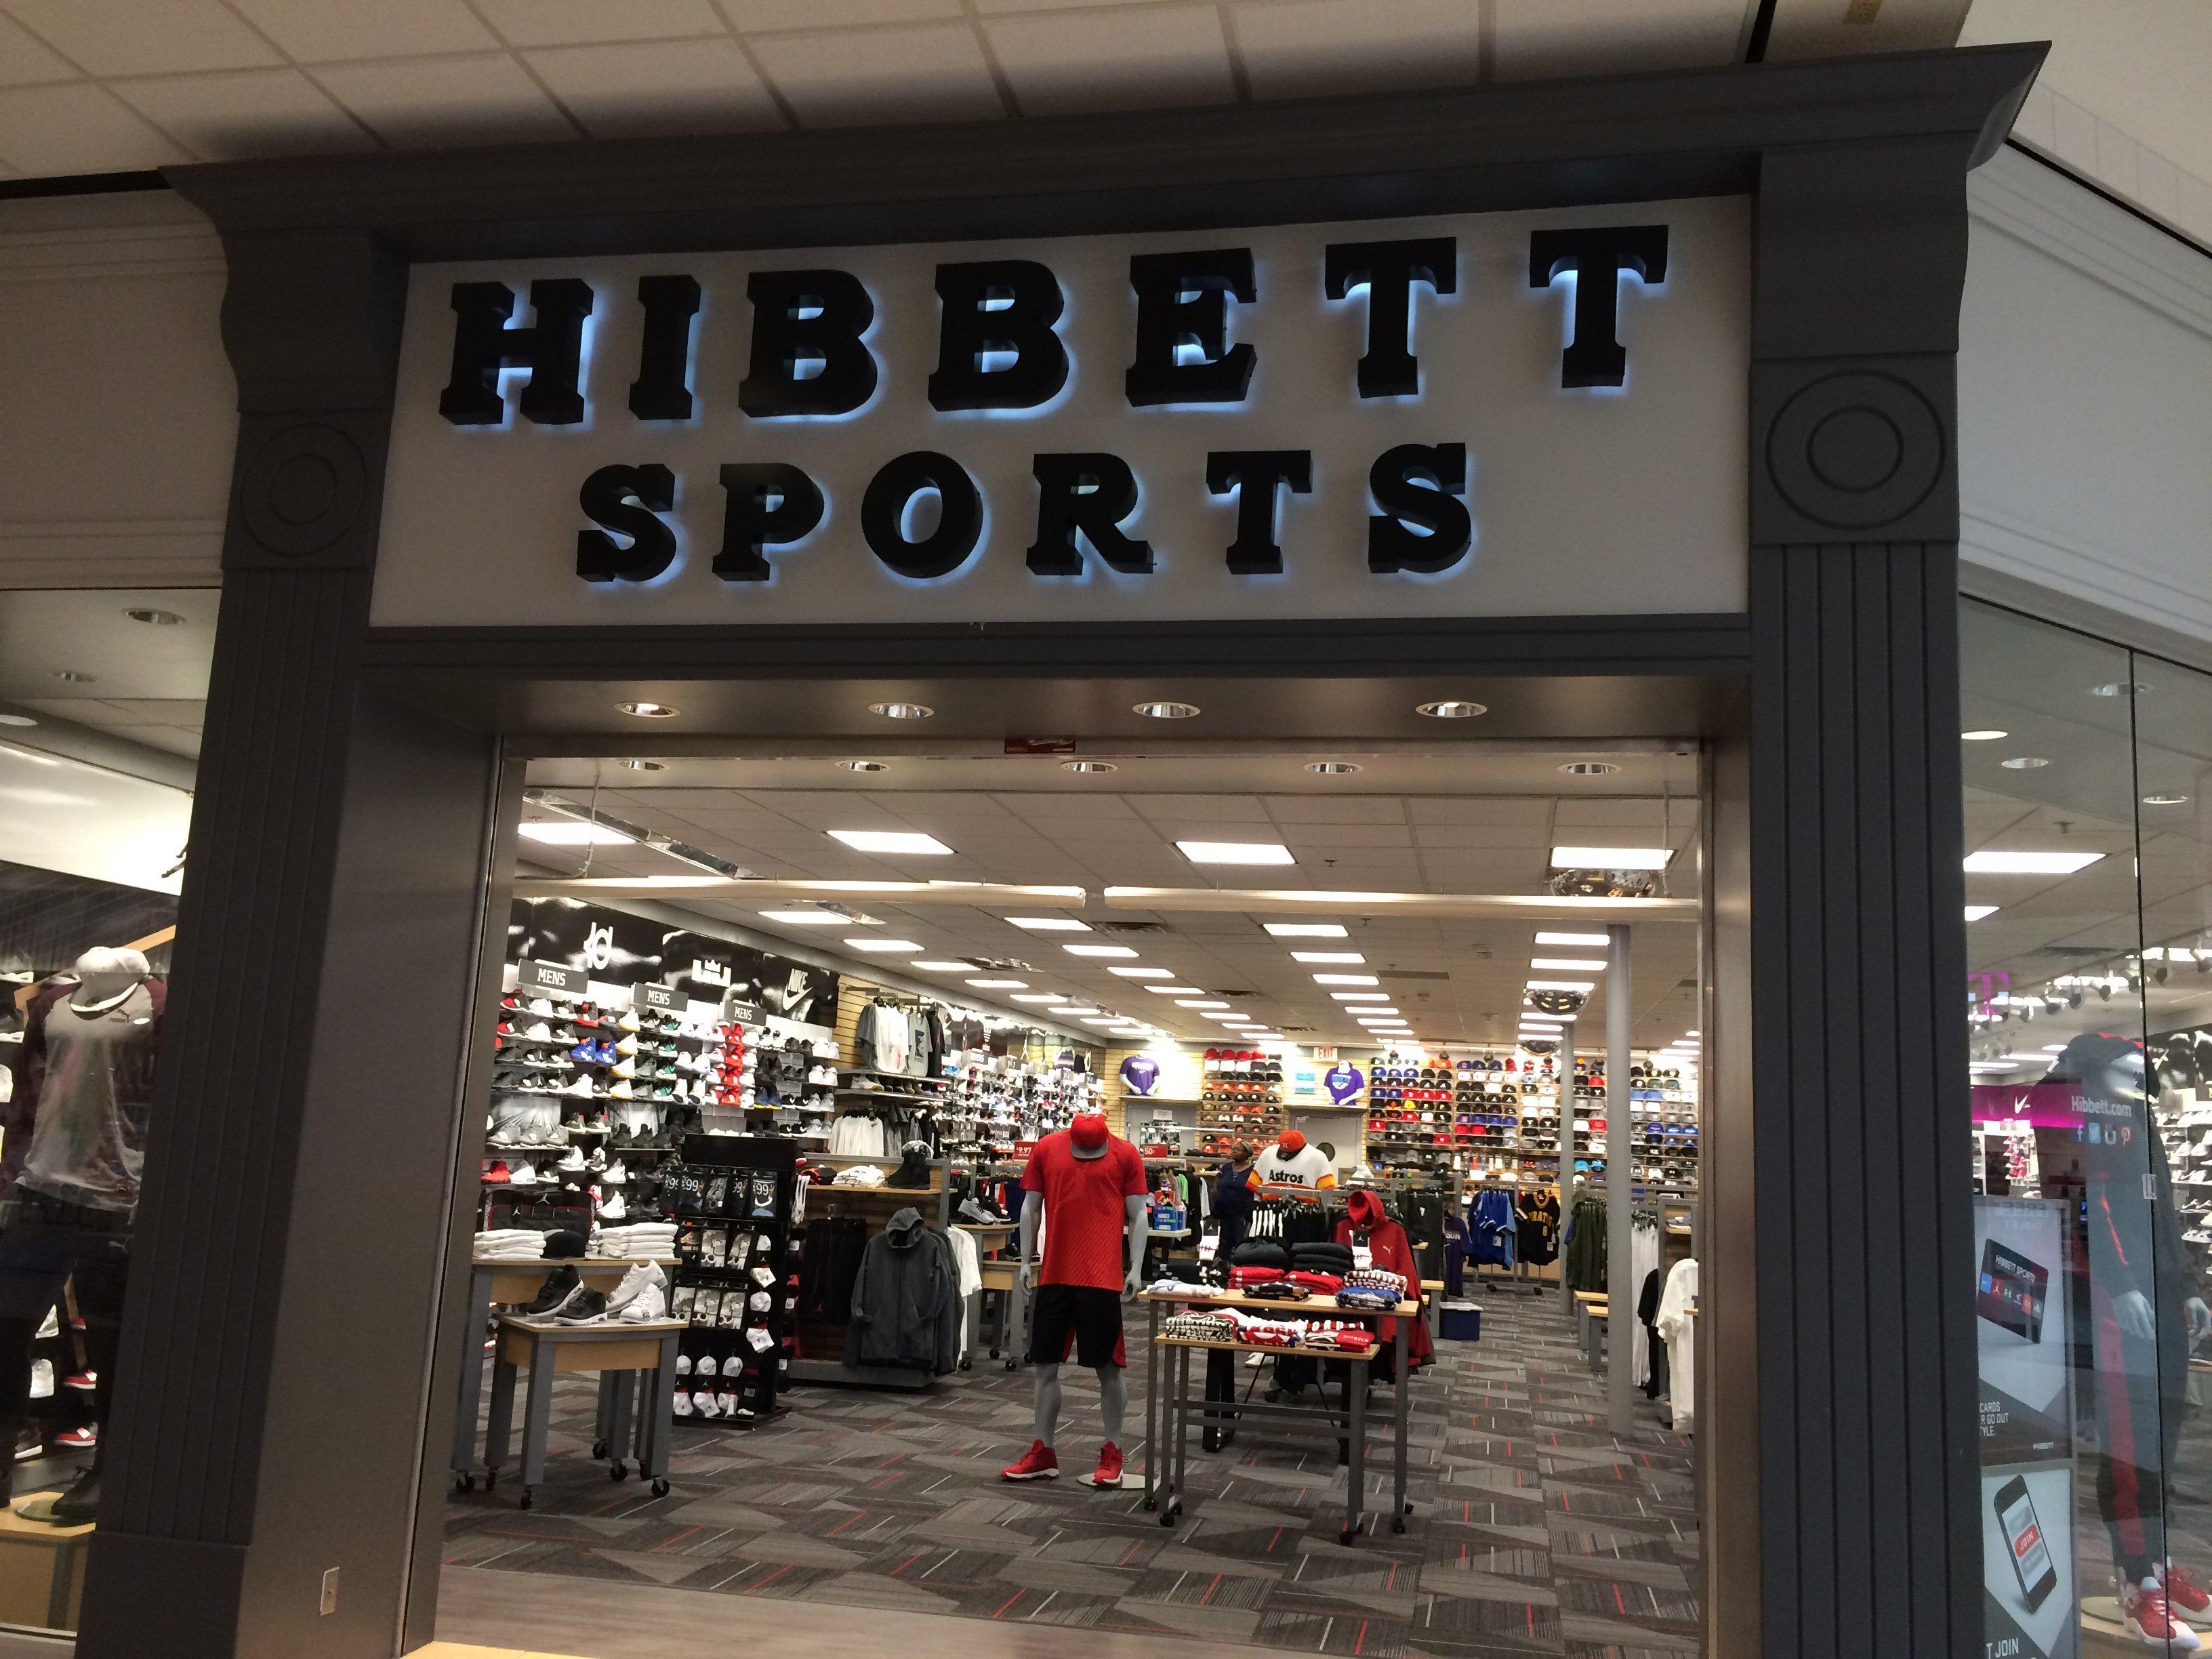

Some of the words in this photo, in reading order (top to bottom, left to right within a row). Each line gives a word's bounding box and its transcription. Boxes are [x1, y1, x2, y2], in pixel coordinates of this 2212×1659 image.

[438, 224, 1668, 426] HIBBETT
[576, 442, 1471, 582] SPORTS
[537, 968, 566, 986] MENS
[787, 968, 808, 994] NIKE
[647, 989, 670, 1006] MENS
[734, 1006, 753, 1021] MENS
[1318, 1048, 1334, 1059] EXIT
[2071, 1095, 2132, 1117] Hibbett.com
[1269, 1169, 1304, 1184] Astros
[1979, 1401, 2001, 1413] CARDS
[1986, 1414, 1996, 1425] GO
[1996, 1413, 2009, 1423] OUT
[2020, 1531, 2034, 1551] JOIN
[1995, 1637, 2019, 1658] JOIN
